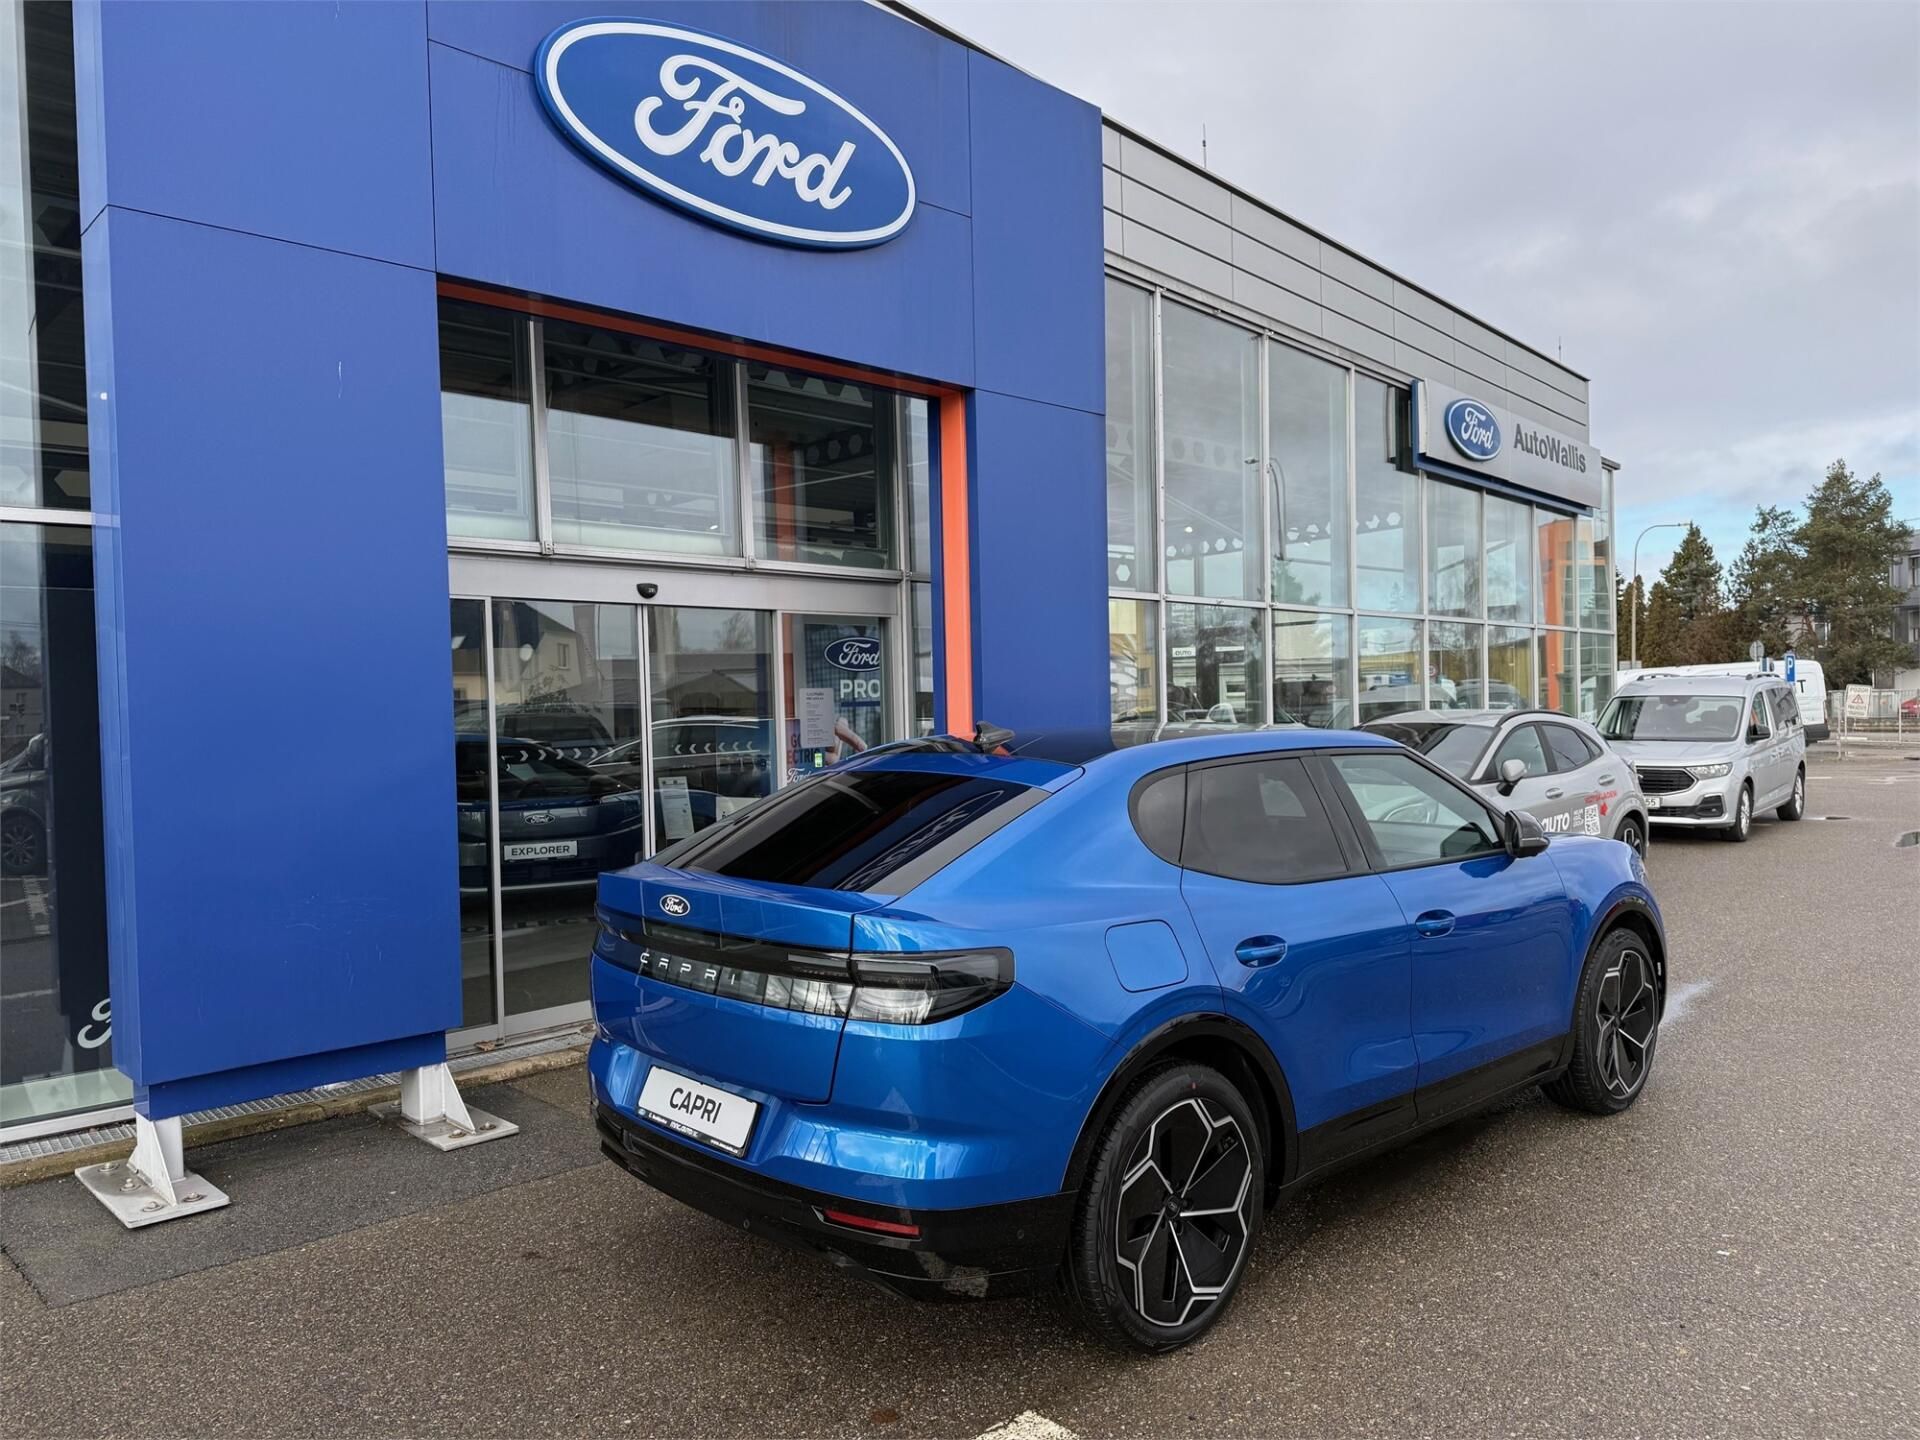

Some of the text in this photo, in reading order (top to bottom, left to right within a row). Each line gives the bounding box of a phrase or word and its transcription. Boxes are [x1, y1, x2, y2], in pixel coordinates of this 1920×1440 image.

[634, 54, 857, 210] Ford
[1461, 407, 1494, 449] Ford
[1513, 423, 1587, 473] AutoWallis
[838, 641, 880, 666] Ford
[839, 679, 881, 699] PRO
[511, 845, 571, 856] EXPLORER
[664, 896, 685, 914] Ford
[640, 951, 736, 985] CAPRI
[669, 1087, 722, 1124] CAPRI
